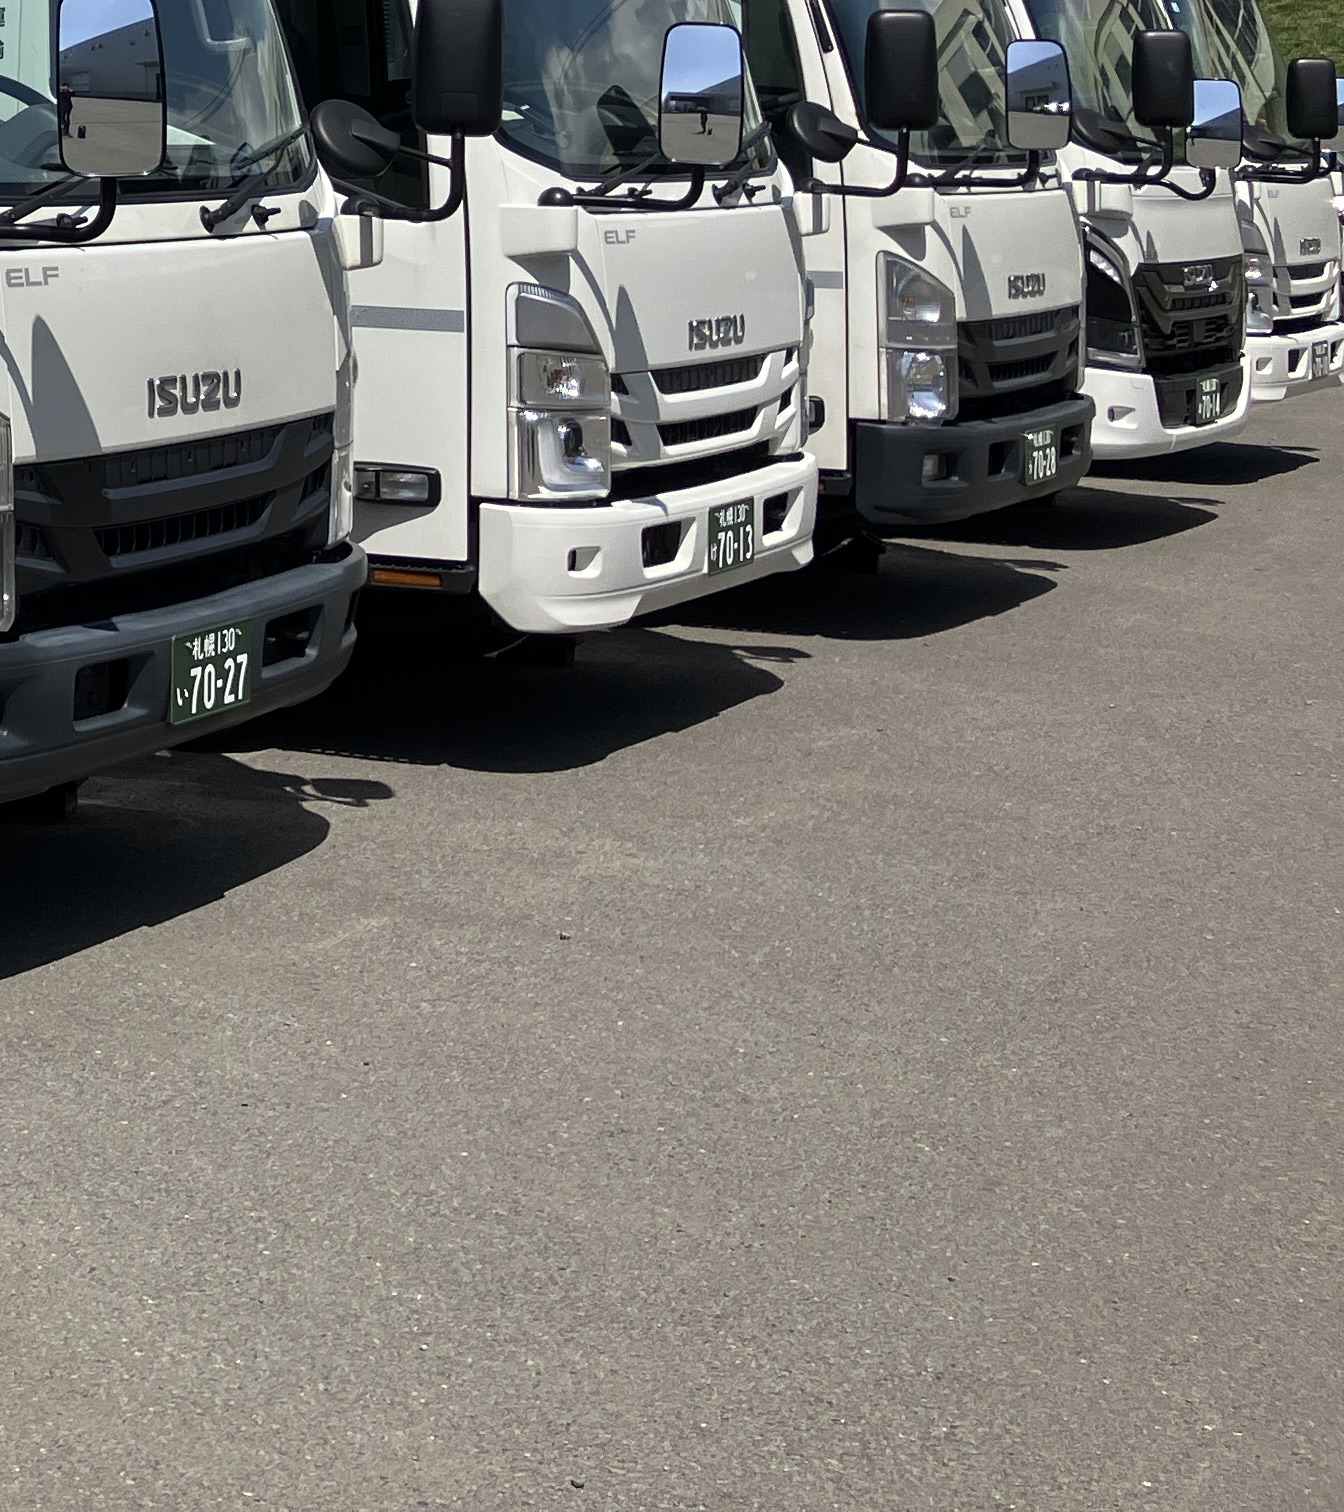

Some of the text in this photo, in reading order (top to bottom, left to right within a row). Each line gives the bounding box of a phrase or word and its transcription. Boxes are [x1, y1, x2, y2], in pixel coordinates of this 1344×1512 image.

[950, 207, 971, 218] ELF
[604, 230, 637, 245] ELF
[5, 266, 60, 288] ELF
[688, 314, 746, 352] ISUZU
[147, 368, 242, 419] ISUZU
[717, 524, 753, 569] 70-13
[176, 653, 248, 715] い 70-27
